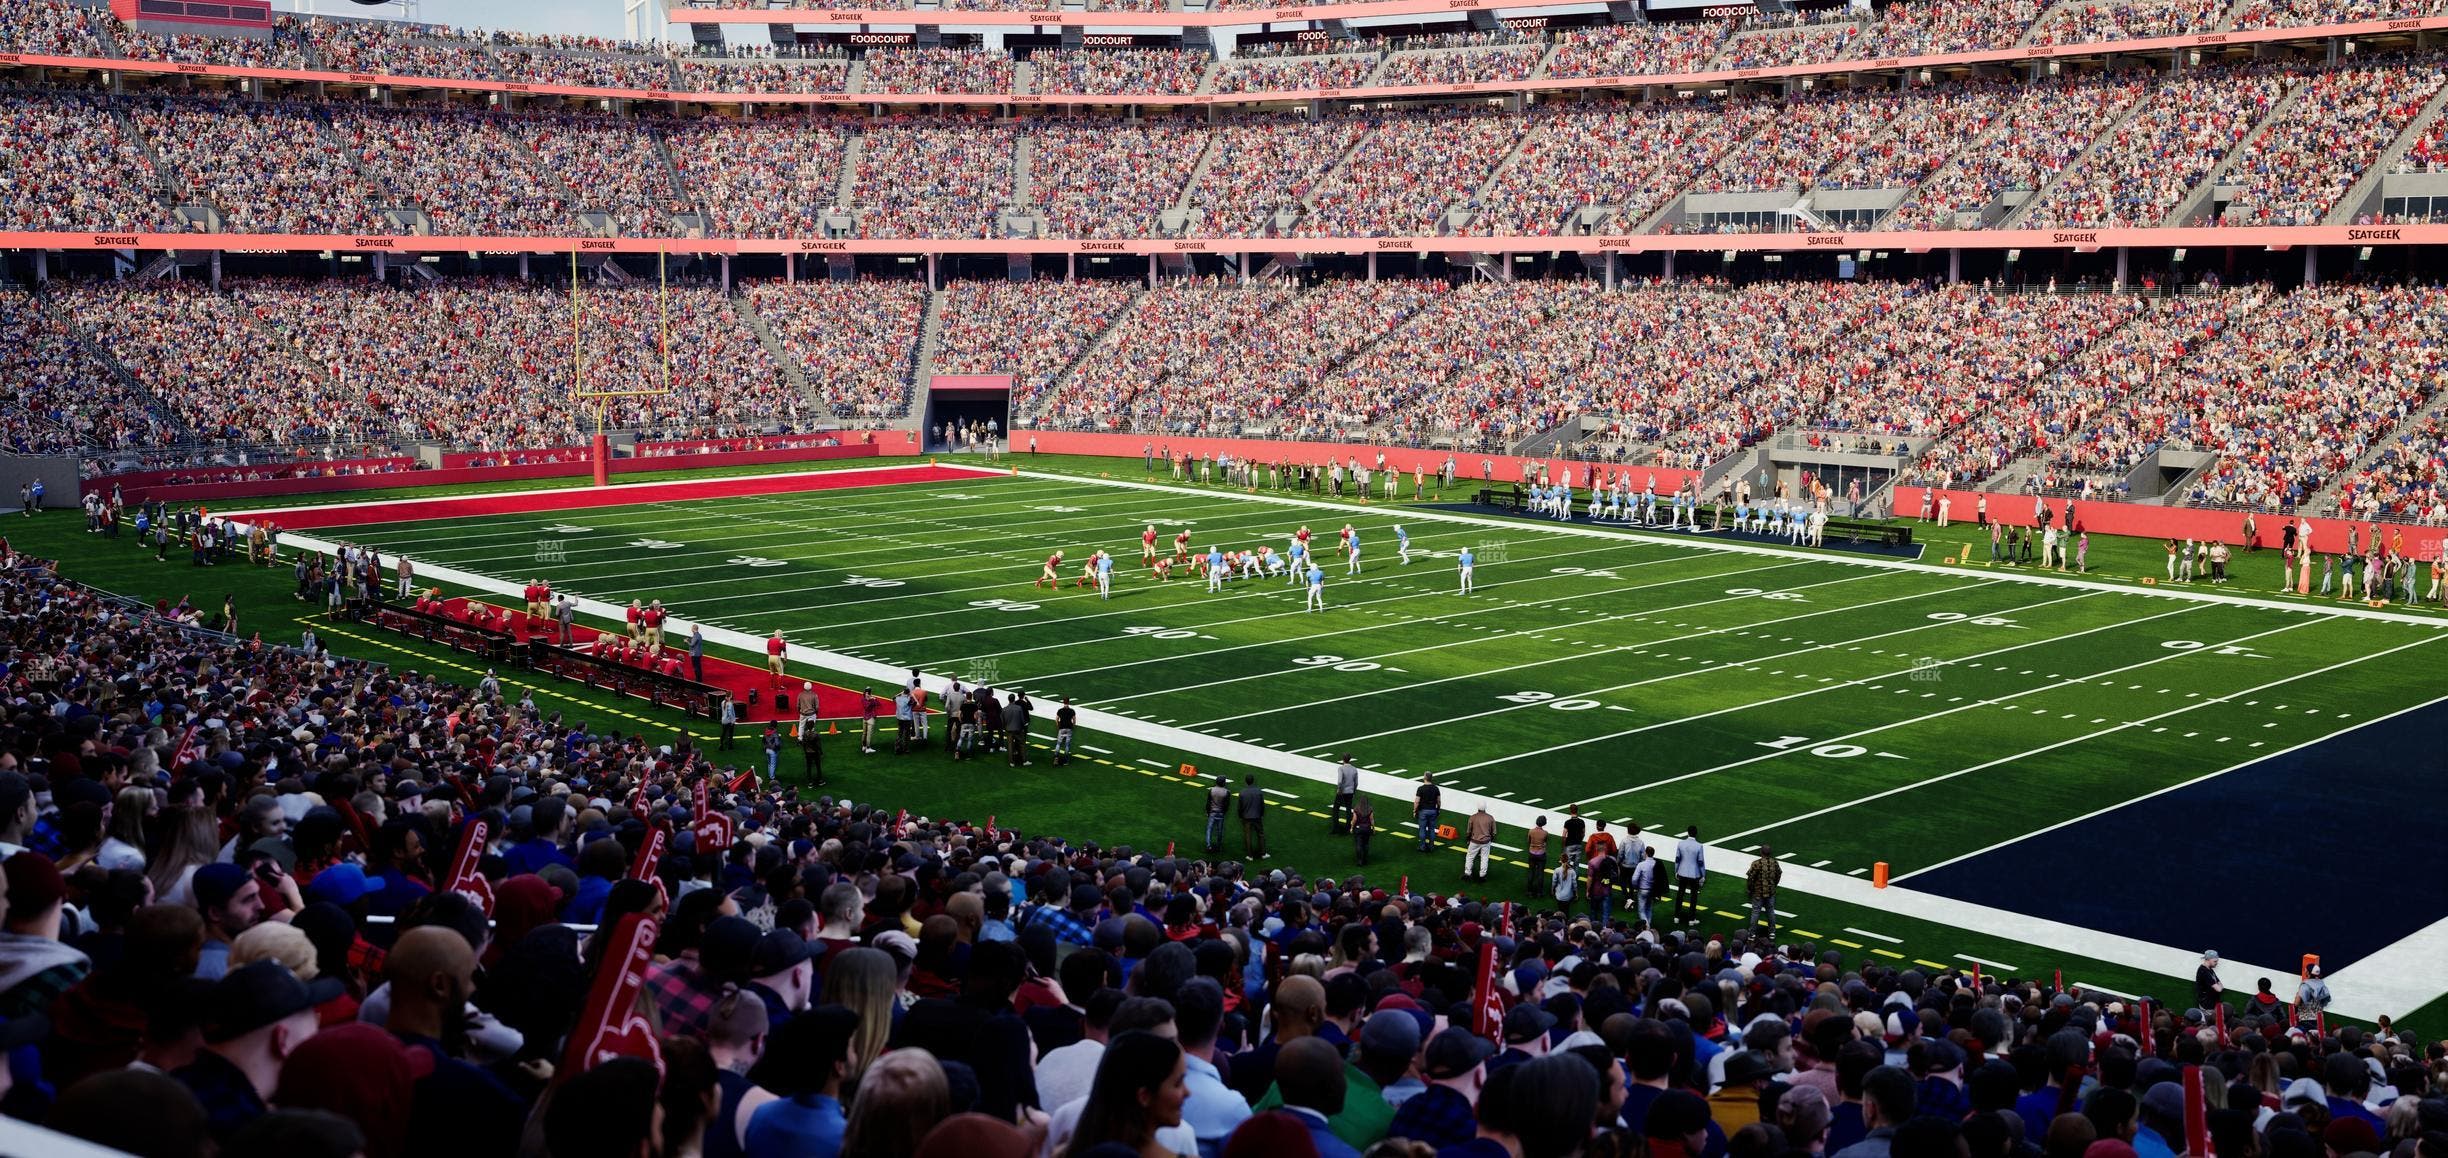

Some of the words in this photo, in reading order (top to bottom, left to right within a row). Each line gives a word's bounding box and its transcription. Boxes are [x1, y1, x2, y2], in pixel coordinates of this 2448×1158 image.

[831, 13, 862, 21] SEATGEEK
[2389, 20, 2421, 29] SEATGEEK
[851, 35, 910, 43] FOODCOURT
[1297, 31, 1328, 40] FOODC
[2197, 35, 2227, 43] SEATGEEK
[2028, 48, 2054, 56] SEATGEEK
[2053, 233, 2096, 243] SEATGEEK
[2348, 229, 2401, 240] SEATGEEK
[94, 236, 139, 246] SEATGEEK
[355, 238, 394, 247] SEATGEEK
[582, 241, 615, 249] SEATGEEK
[1378, 240, 1413, 249] SEATGEEK
[1599, 239, 1630, 247] SEATGEEK
[1808, 236, 1844, 246] SEATGEEK
[801, 242, 846, 250] SEATGEEK
[1081, 242, 1125, 250] SEATGEEK
[1174, 242, 1206, 250] SEATGEEK
[968, 599, 1041, 611] 50
[1121, 626, 1197, 639] 40
[1291, 655, 1382, 671] 30
[1496, 691, 1601, 710] 20
[1754, 735, 1868, 758] 10
[1443, 827, 1451, 836] 10
